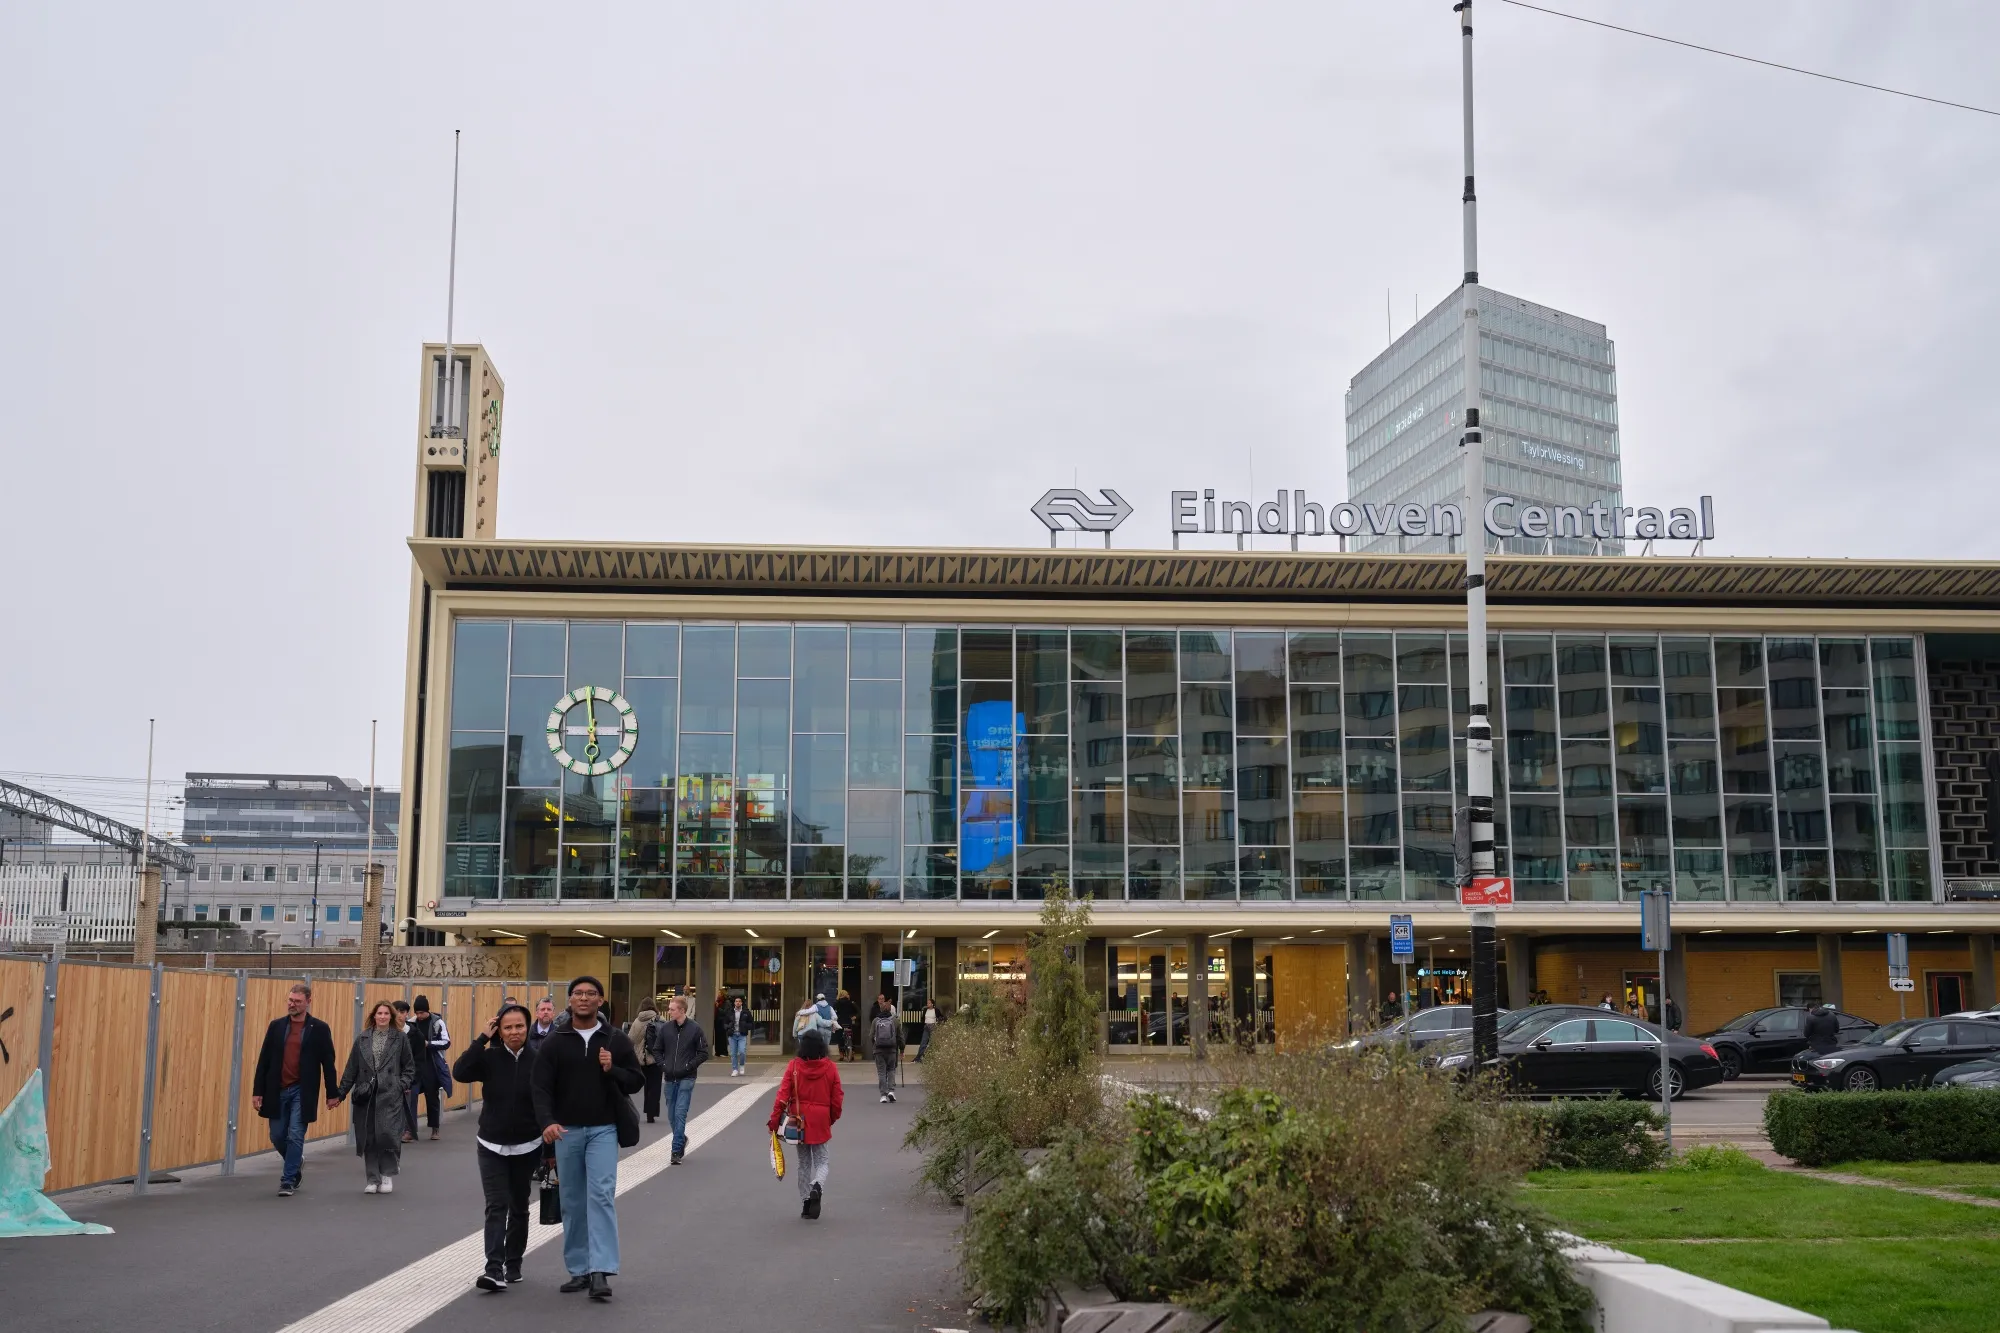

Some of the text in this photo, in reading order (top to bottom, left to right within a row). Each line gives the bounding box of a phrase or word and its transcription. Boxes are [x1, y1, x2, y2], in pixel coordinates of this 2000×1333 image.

[1521, 440, 1584, 470] TaylorWessing
[1171, 488, 1715, 540] Eindhoven Centraal
